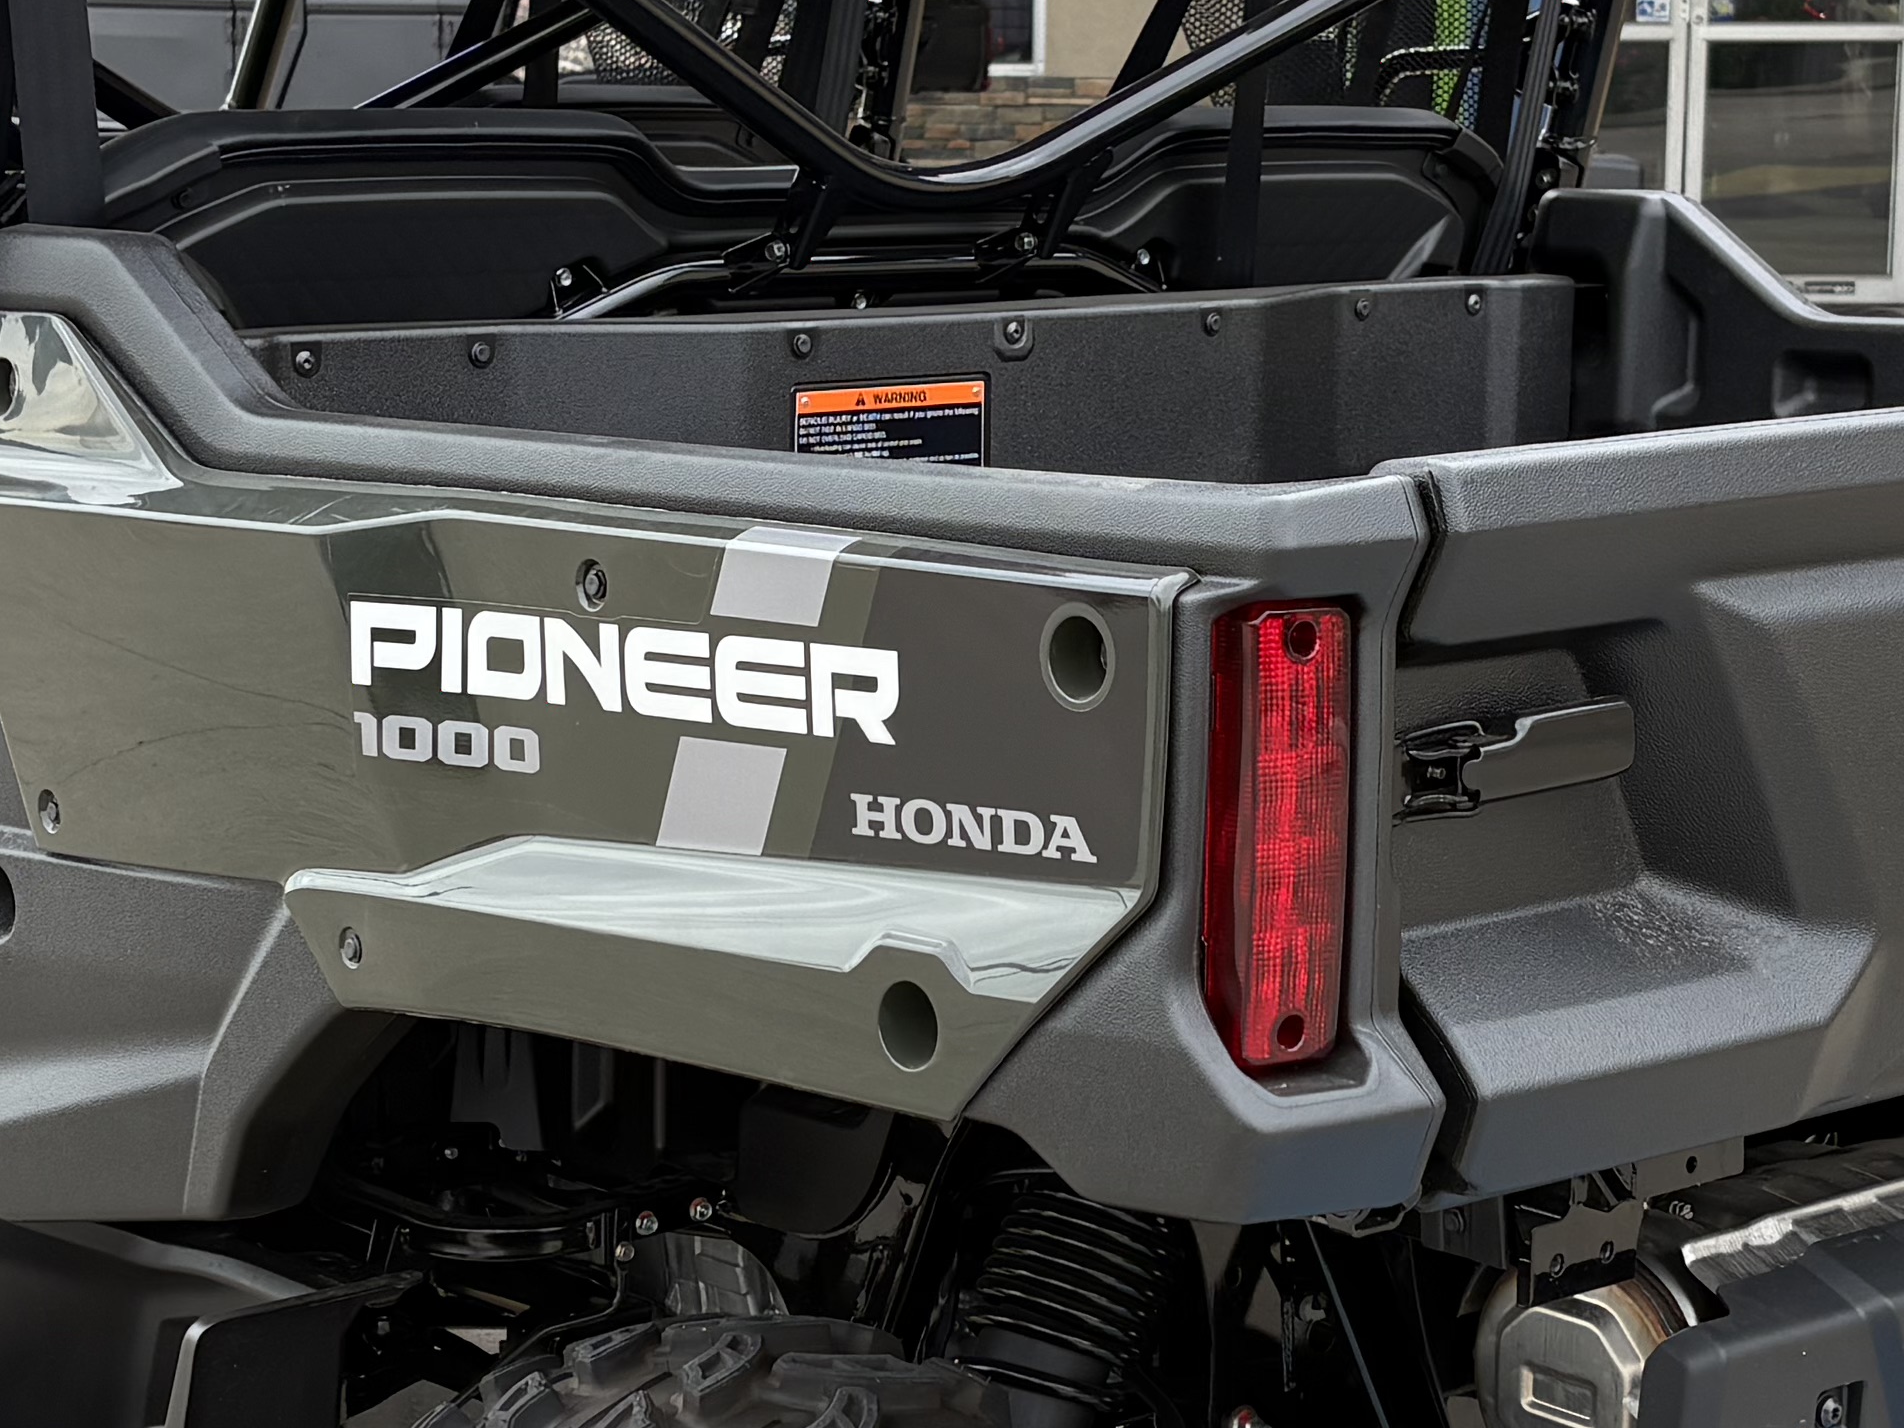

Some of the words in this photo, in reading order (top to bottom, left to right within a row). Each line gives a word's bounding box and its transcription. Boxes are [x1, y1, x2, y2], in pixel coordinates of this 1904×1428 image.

[872, 389, 928, 405] WARNING
[350, 600, 897, 745] PIONEER
[353, 711, 541, 774] 1000
[851, 792, 1097, 864] HONDA
